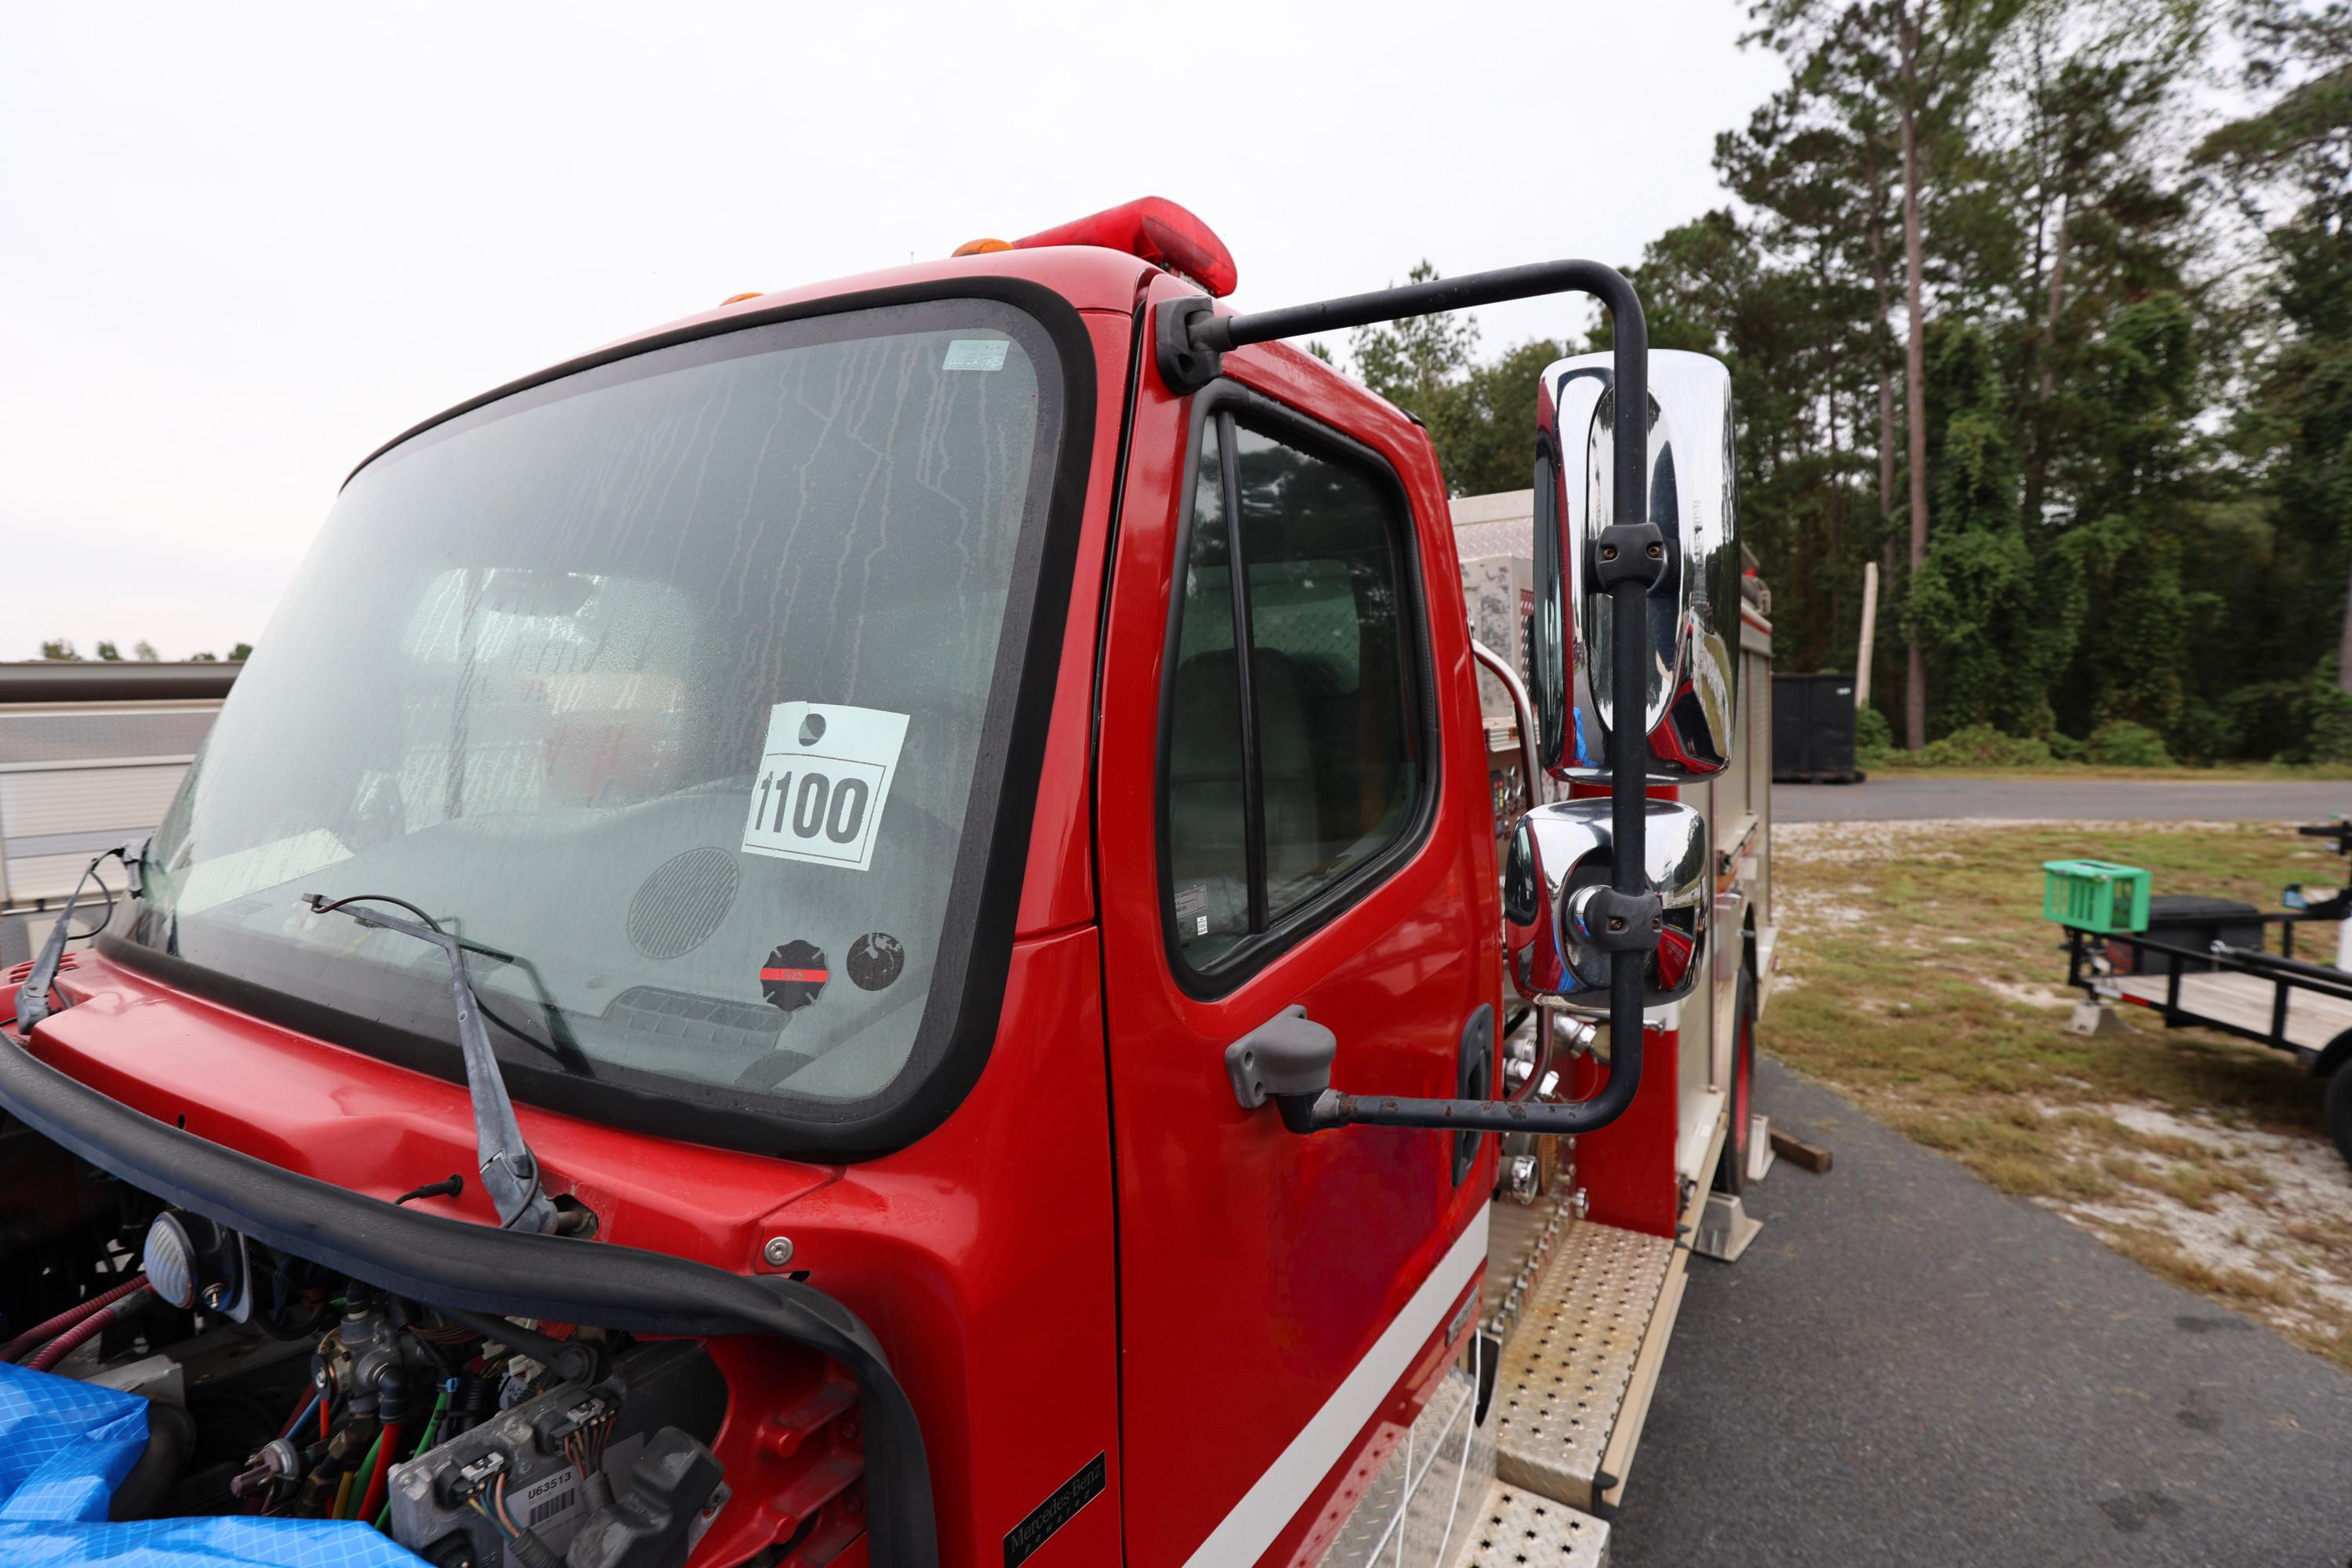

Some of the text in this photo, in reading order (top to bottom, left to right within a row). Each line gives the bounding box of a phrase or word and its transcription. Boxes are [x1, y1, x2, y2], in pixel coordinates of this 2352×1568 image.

[755, 771, 869, 844] 1100
[528, 1472, 572, 1499] U63513
[1011, 1464, 1102, 1554] Mercedes-Benz
